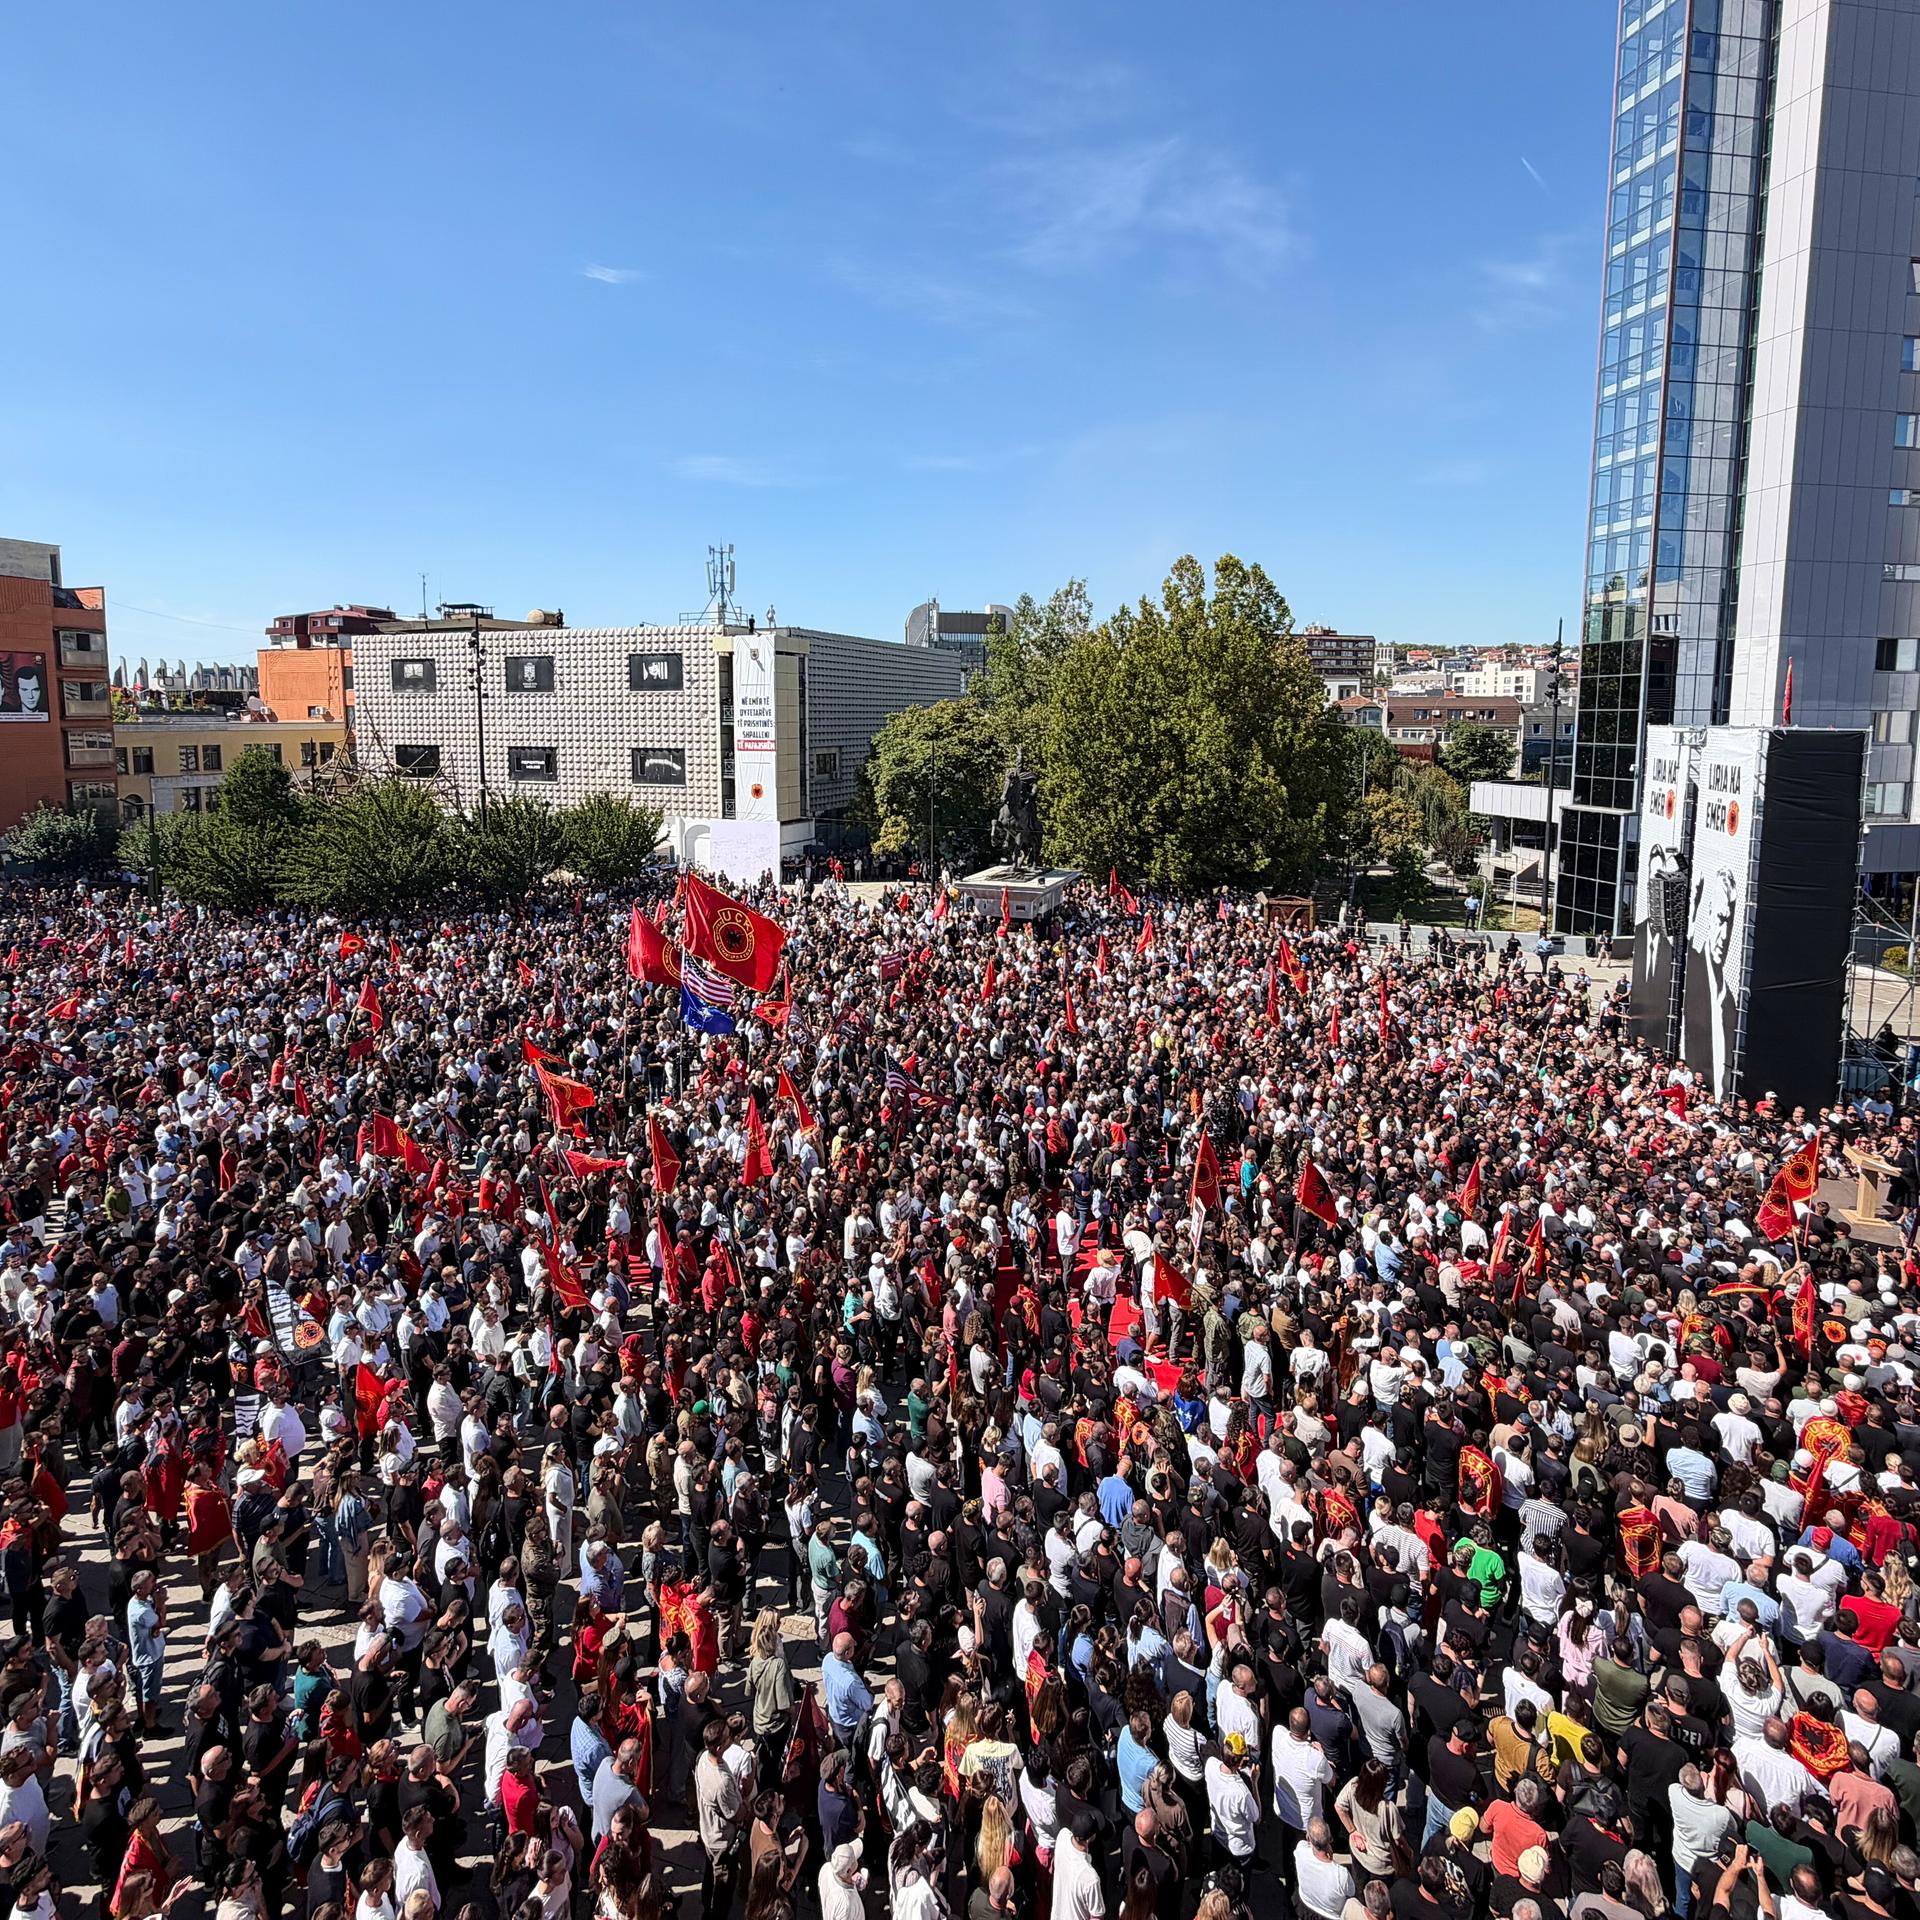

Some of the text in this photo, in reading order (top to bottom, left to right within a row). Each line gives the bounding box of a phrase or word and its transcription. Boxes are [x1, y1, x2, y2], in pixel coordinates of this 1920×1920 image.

[1653, 758, 1667, 782] LIRIA
[1709, 763, 1741, 795] LIRIA KA
[1649, 787, 1666, 816] EMËR
[1706, 798, 1727, 832] EMËR
[1670, 1725, 1702, 1746] LIZEI
